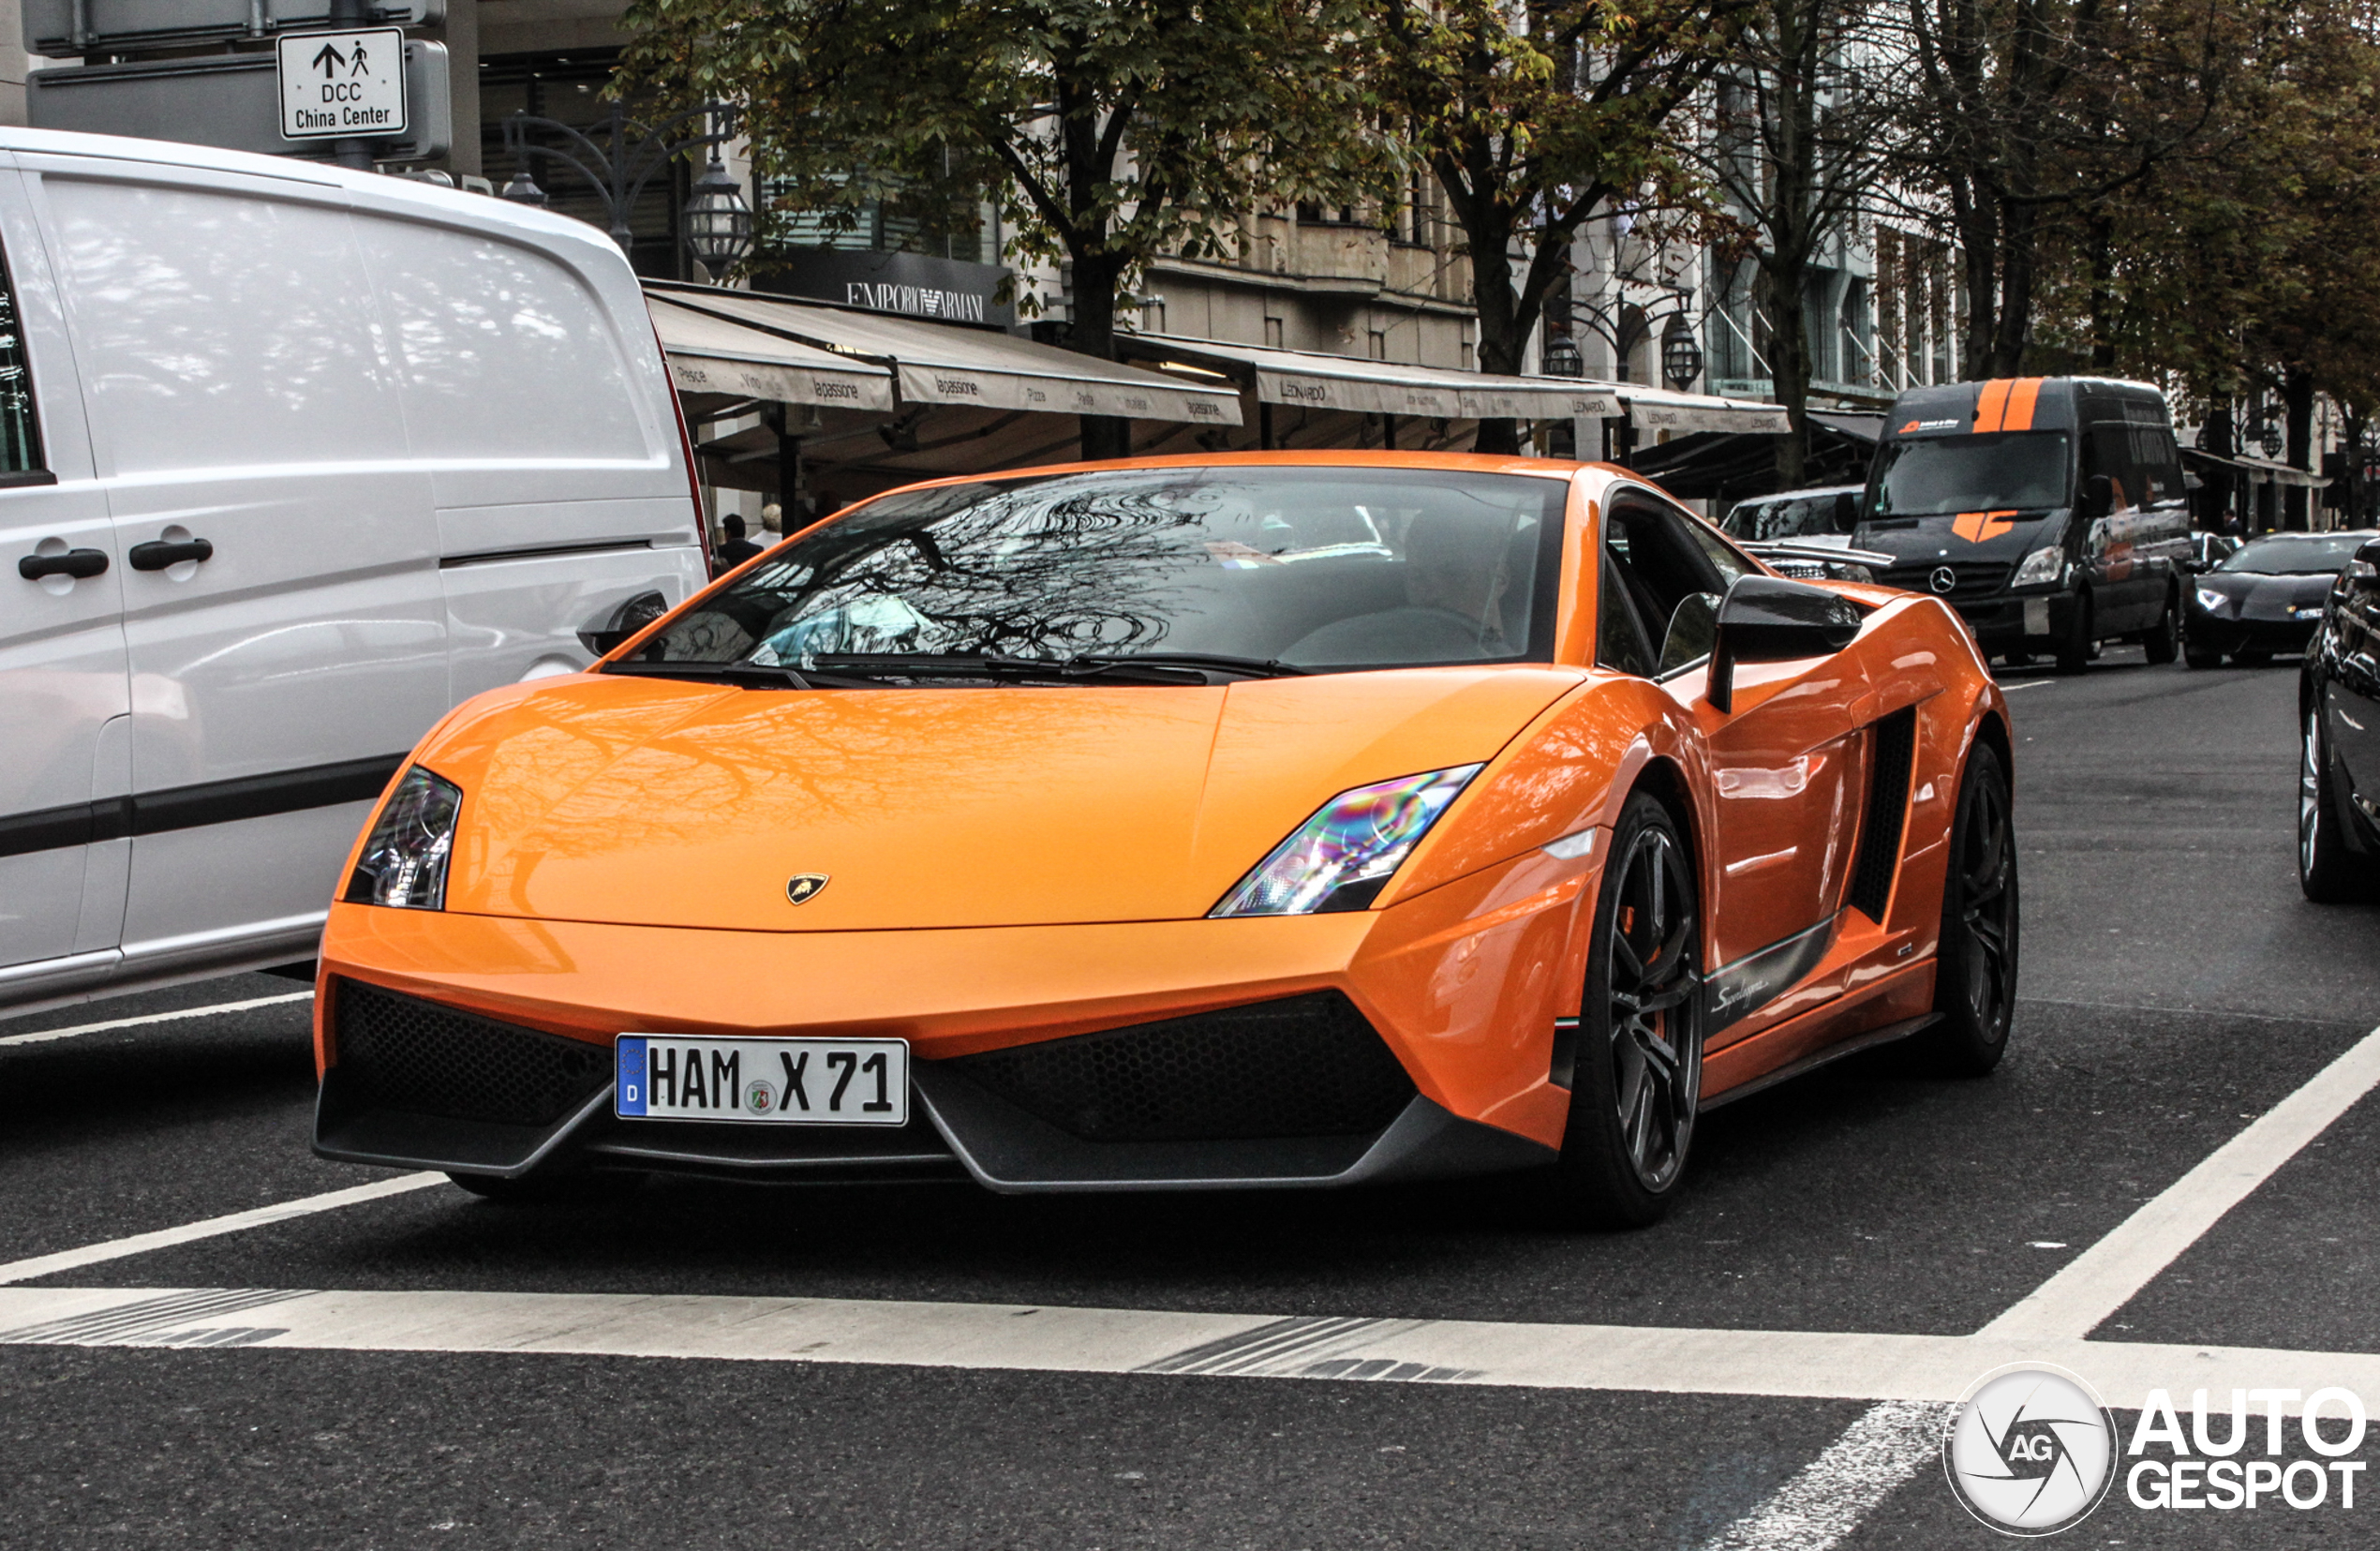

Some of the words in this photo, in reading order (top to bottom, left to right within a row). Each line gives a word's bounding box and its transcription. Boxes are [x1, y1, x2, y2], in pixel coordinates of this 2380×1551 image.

[321, 82, 362, 103] DCC
[296, 108, 336, 128] China
[343, 106, 391, 126] Center
[847, 282, 924, 314] EMPORIO
[939, 291, 983, 322] ARMANI
[677, 366, 707, 383] Pesce
[1027, 388, 1047, 402] Pizza
[627, 1084, 638, 1102] D
[649, 1047, 739, 1109] HAM
[780, 1051, 810, 1111] X
[826, 1051, 893, 1112] 71
